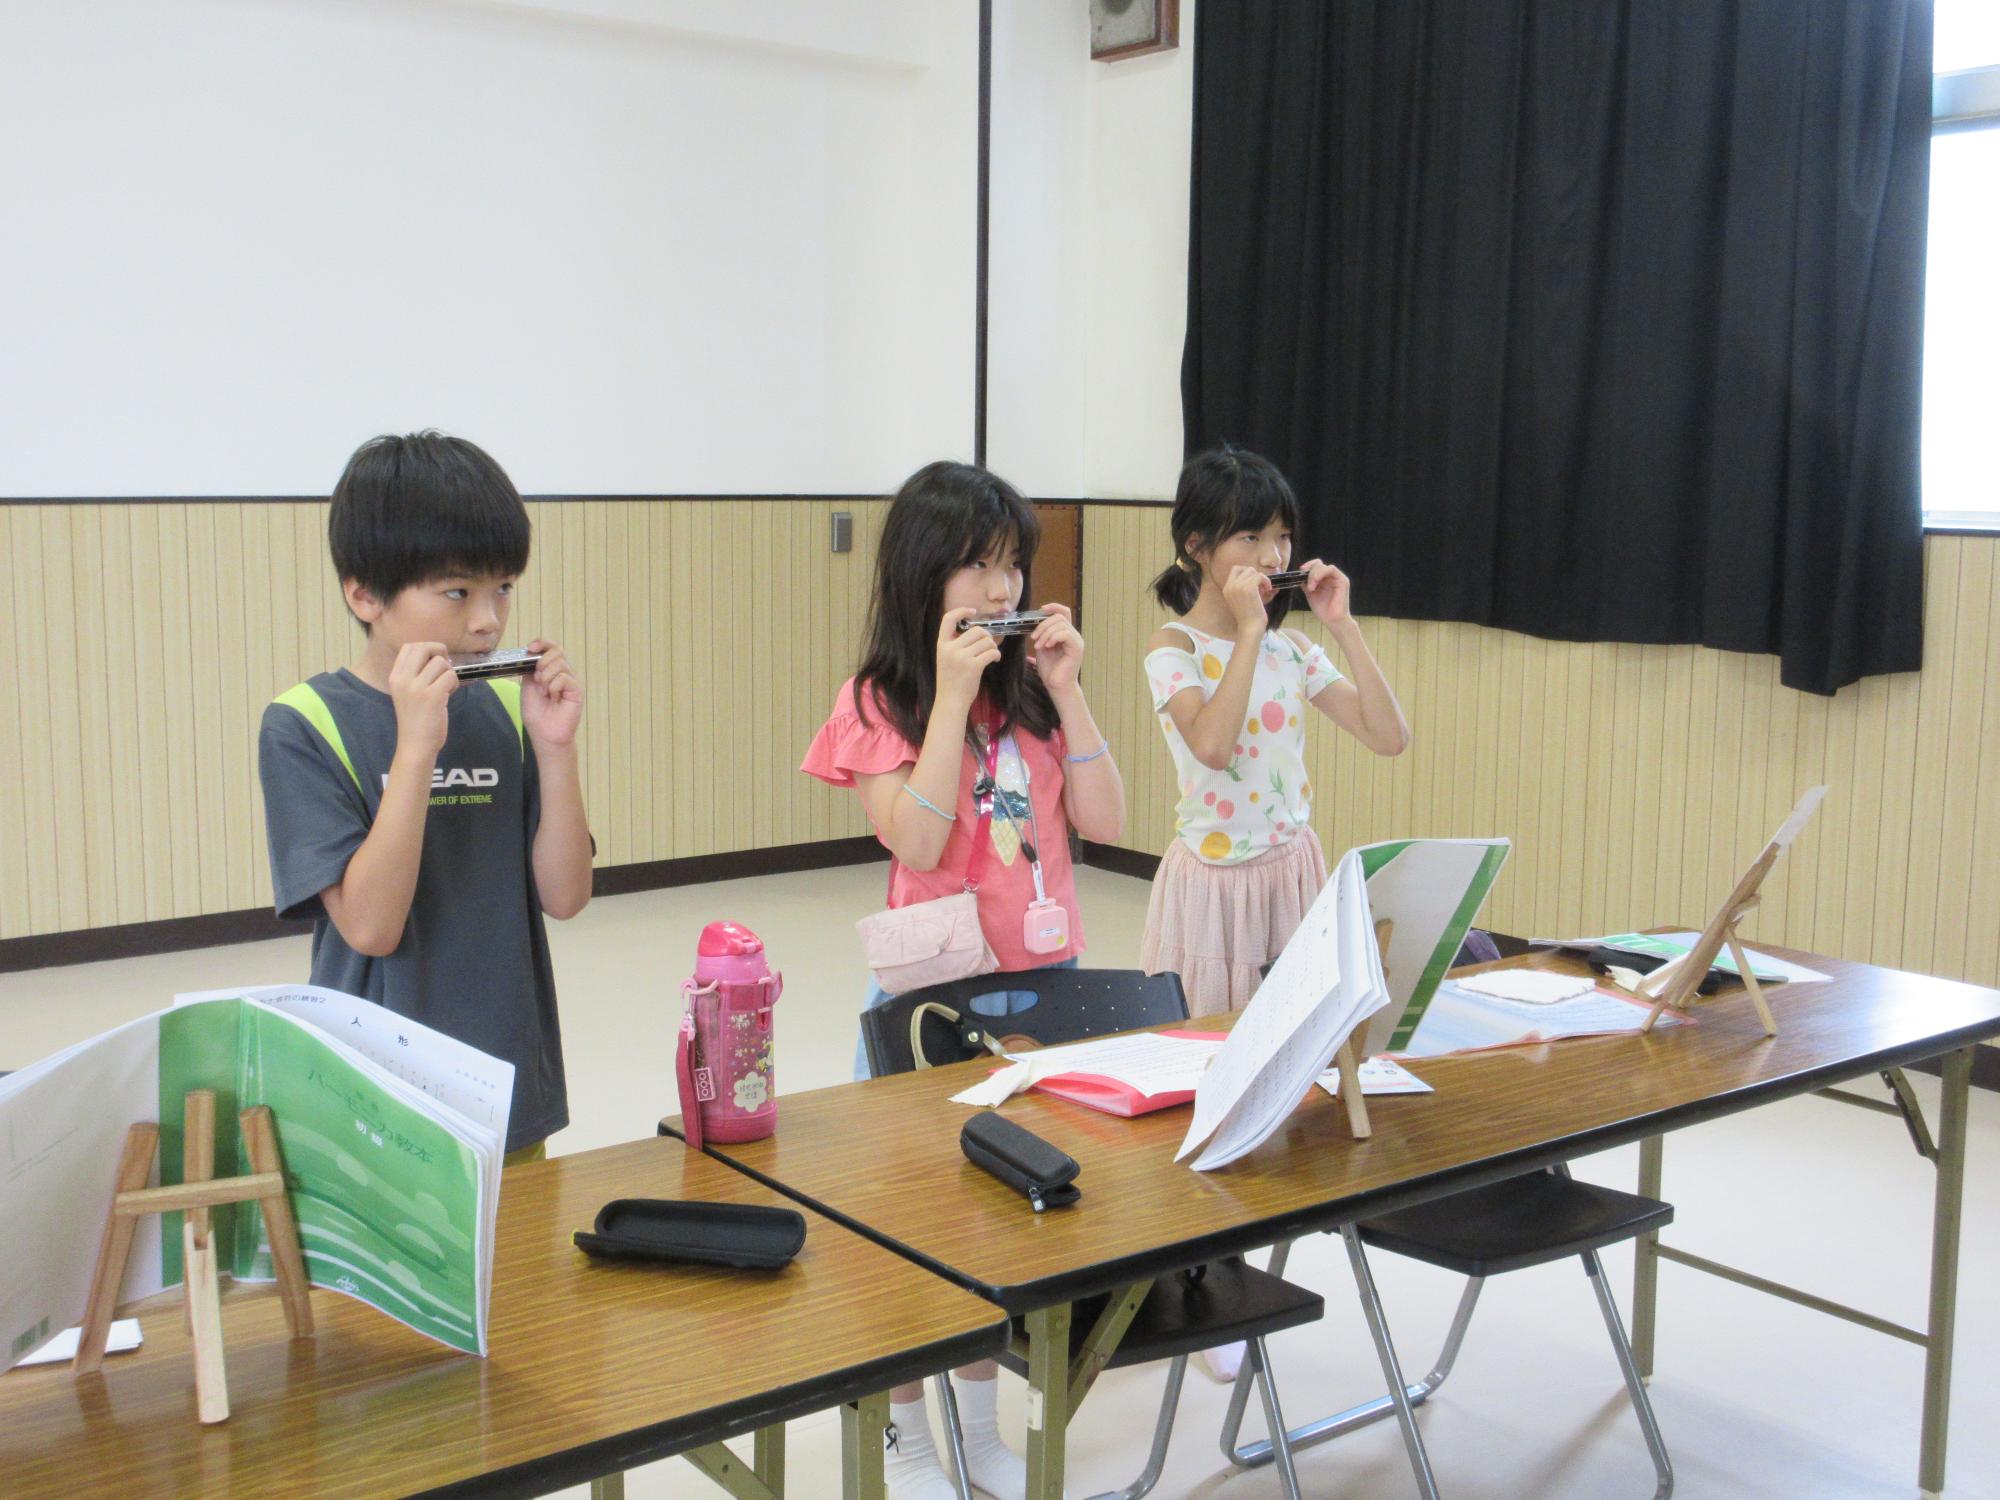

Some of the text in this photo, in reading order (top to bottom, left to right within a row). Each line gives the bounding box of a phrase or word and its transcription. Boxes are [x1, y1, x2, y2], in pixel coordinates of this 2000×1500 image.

[381, 767, 499, 790] EAD
[448, 795, 458, 804] OF
[460, 794, 493, 804] EXTREME
